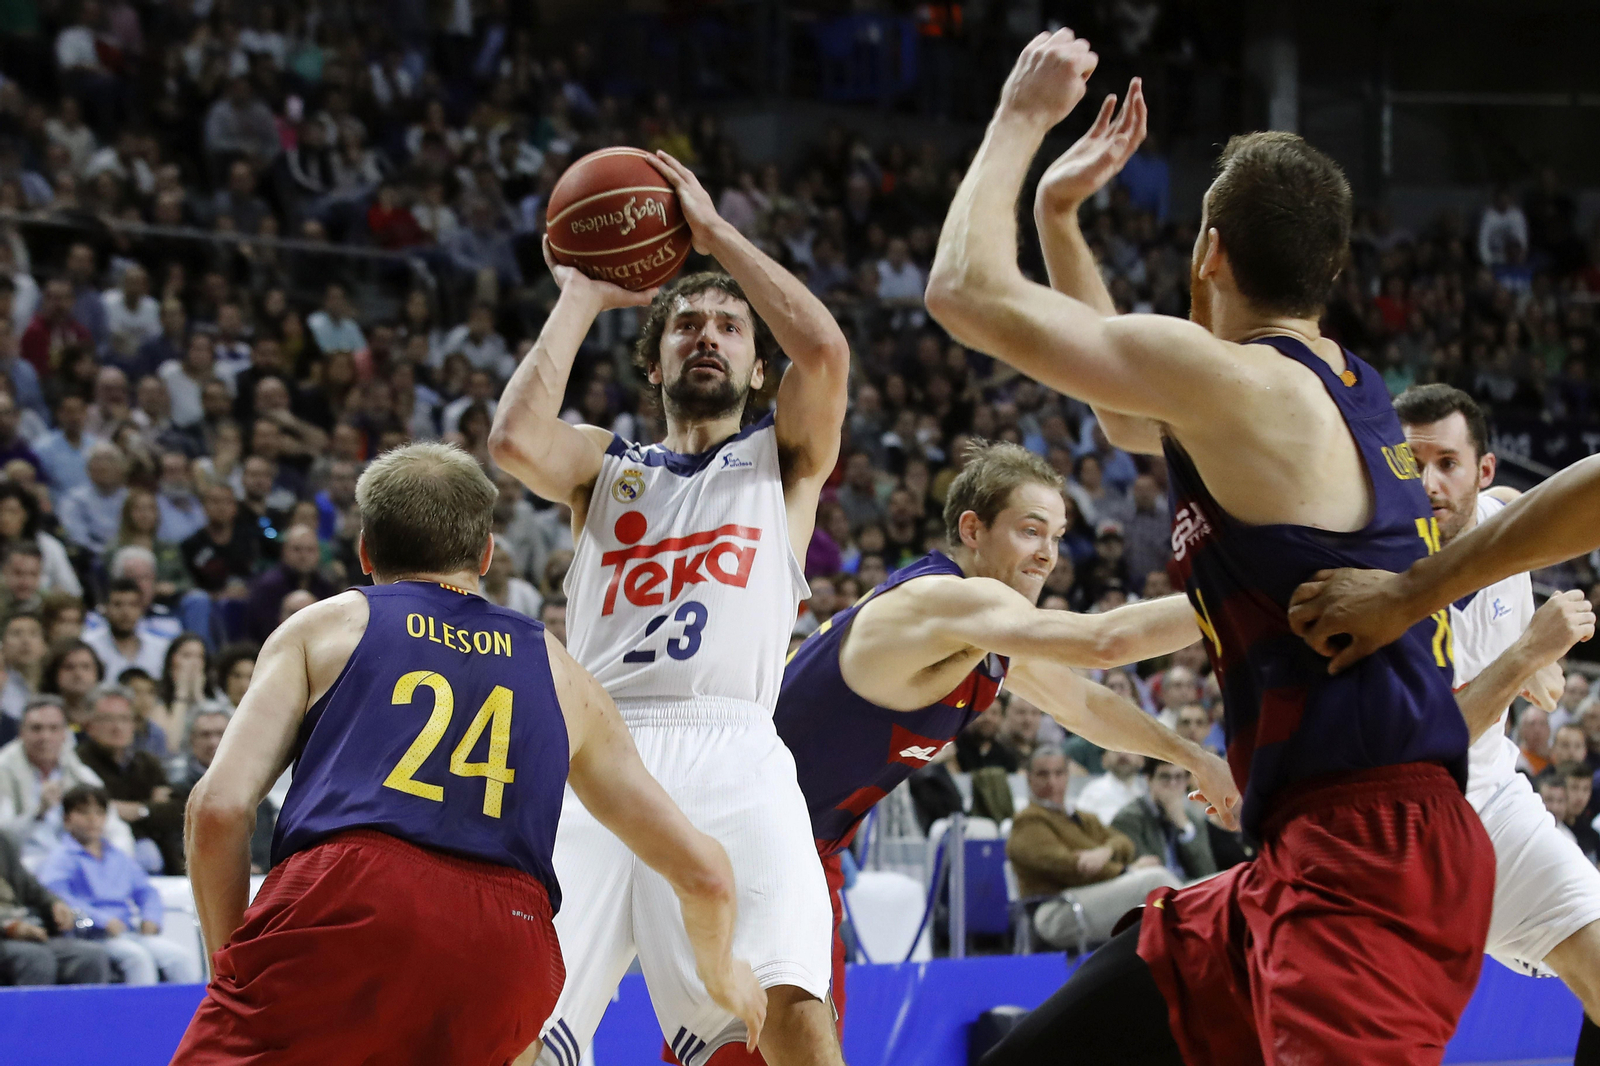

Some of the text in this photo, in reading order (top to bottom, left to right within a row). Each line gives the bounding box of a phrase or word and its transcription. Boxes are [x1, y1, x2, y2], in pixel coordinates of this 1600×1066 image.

[406, 613, 512, 657] OLESON
[622, 600, 708, 664] 23
[382, 670, 516, 819] 24
